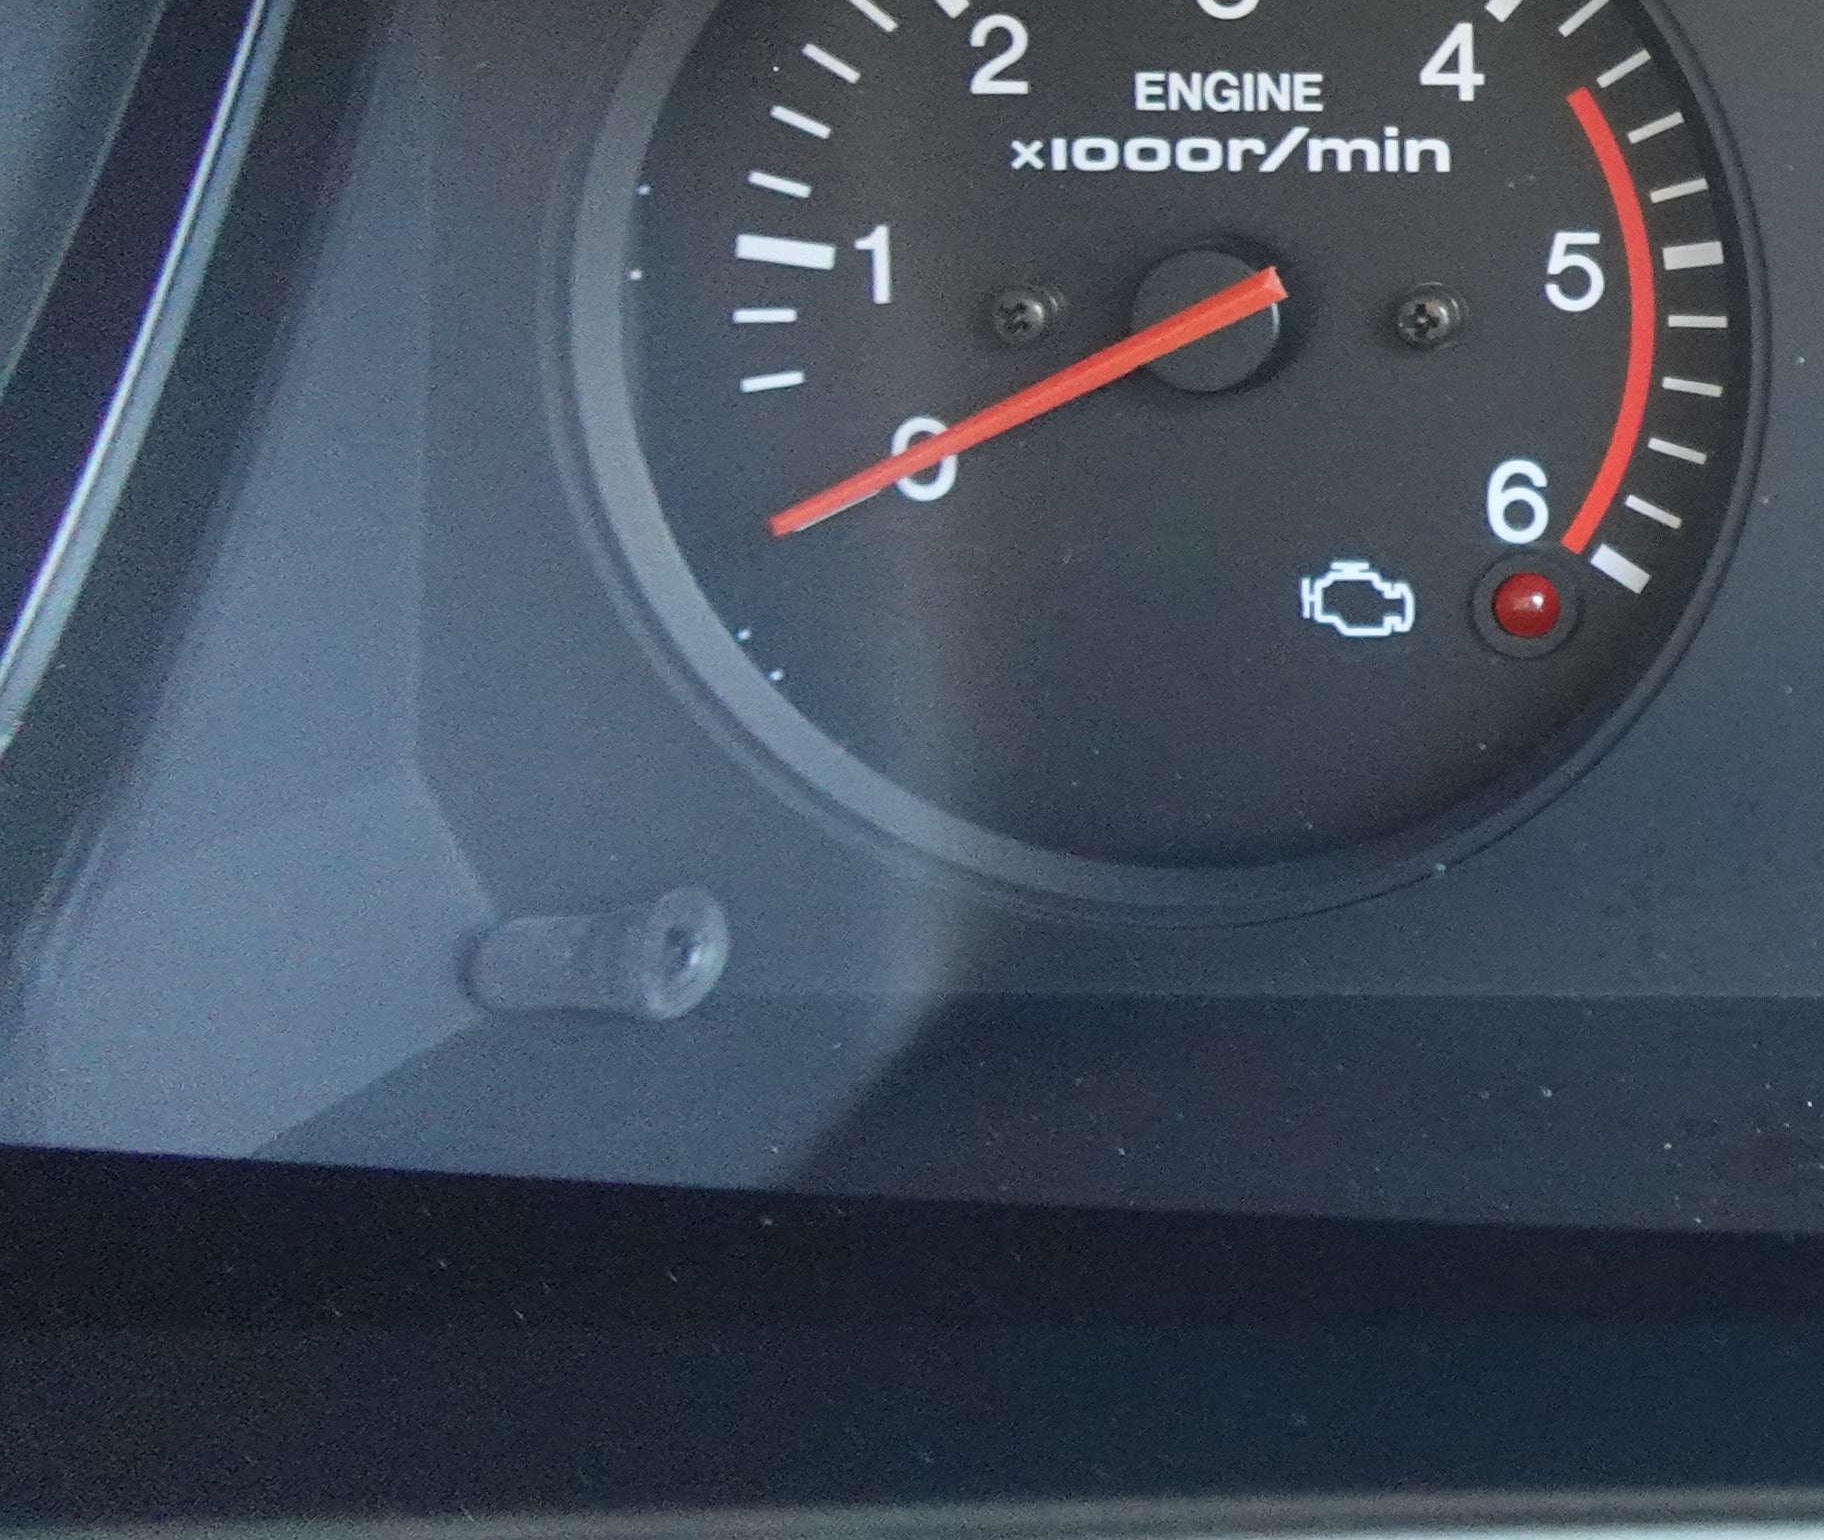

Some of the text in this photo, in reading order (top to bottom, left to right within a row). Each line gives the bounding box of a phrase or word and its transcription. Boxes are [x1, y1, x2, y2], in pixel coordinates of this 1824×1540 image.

[969, 13, 1030, 96] 2
[1133, 69, 1325, 114] ENGINE
[1418, 21, 1486, 103] 4
[853, 223, 892, 306] 1
[1544, 230, 1606, 313] 5
[890, 416, 958, 502] 0
[1486, 458, 1550, 546] 6
